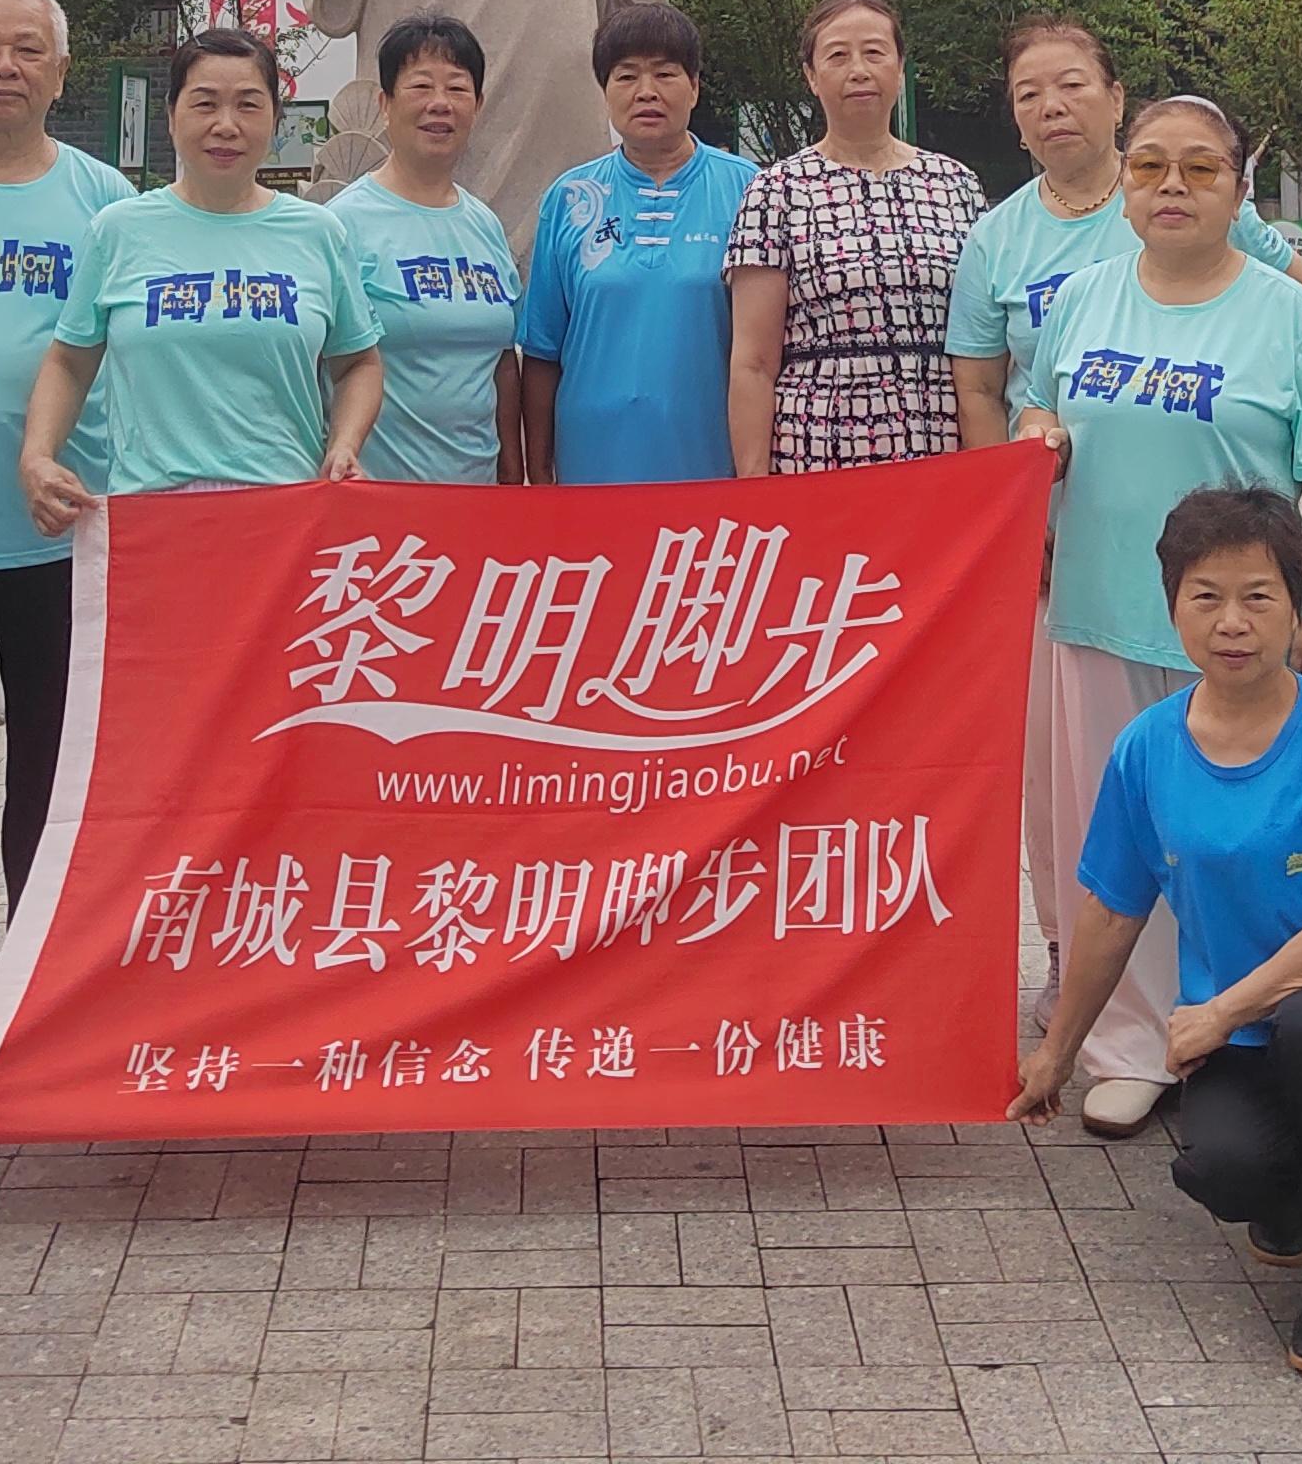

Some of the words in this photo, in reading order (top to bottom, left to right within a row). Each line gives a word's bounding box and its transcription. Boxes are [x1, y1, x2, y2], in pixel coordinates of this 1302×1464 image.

[595, 216, 623, 244] 武
[145, 269, 299, 328] 南城
[1067, 347, 1225, 423] 南城
[286, 517, 903, 723] 黎明脚步
[377, 734, 849, 814] www.limingjiaobu.net
[119, 814, 954, 974] 南城县黎明脚步团队
[117, 1037, 493, 1096] 坚持一种信念
[524, 1012, 887, 1083] 传递一份健康
